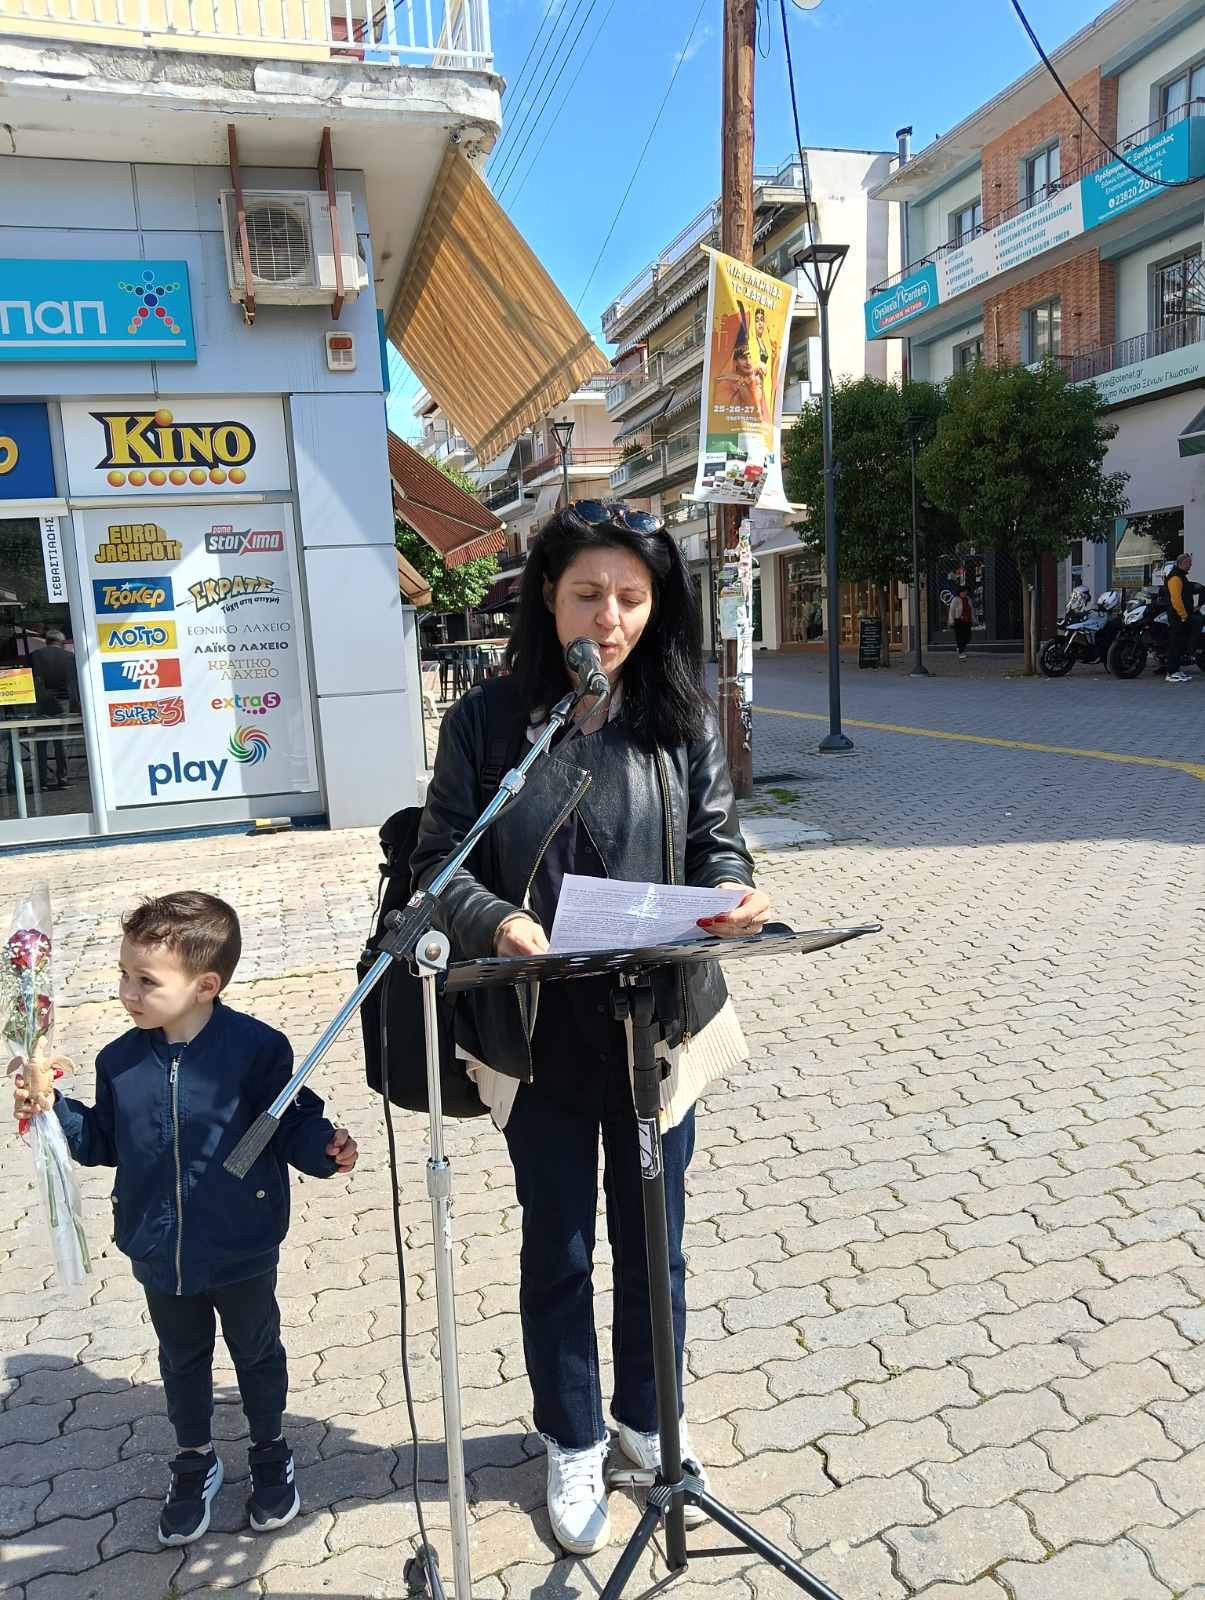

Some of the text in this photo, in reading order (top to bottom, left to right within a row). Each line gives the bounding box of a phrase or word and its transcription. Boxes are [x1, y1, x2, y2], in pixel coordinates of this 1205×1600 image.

[108, 523, 161, 545] EURO
[95, 540, 181, 563] JACKPOT
[108, 625, 167, 647] ΛΟΤΤΟ
[187, 622, 291, 636] ΕΘΝΙΚΟ ΛΑΧΕΙΟ
[194, 641, 290, 654] ΛΑΪΚΟ ΛΑΧΕΙΟ
[207, 657, 272, 671] ΚΡΑΤΙΚΟ
[220, 667, 280, 681] ΛΑΧΕΙΟ
[114, 706, 161, 724] SUPER
[147, 751, 229, 796] play
